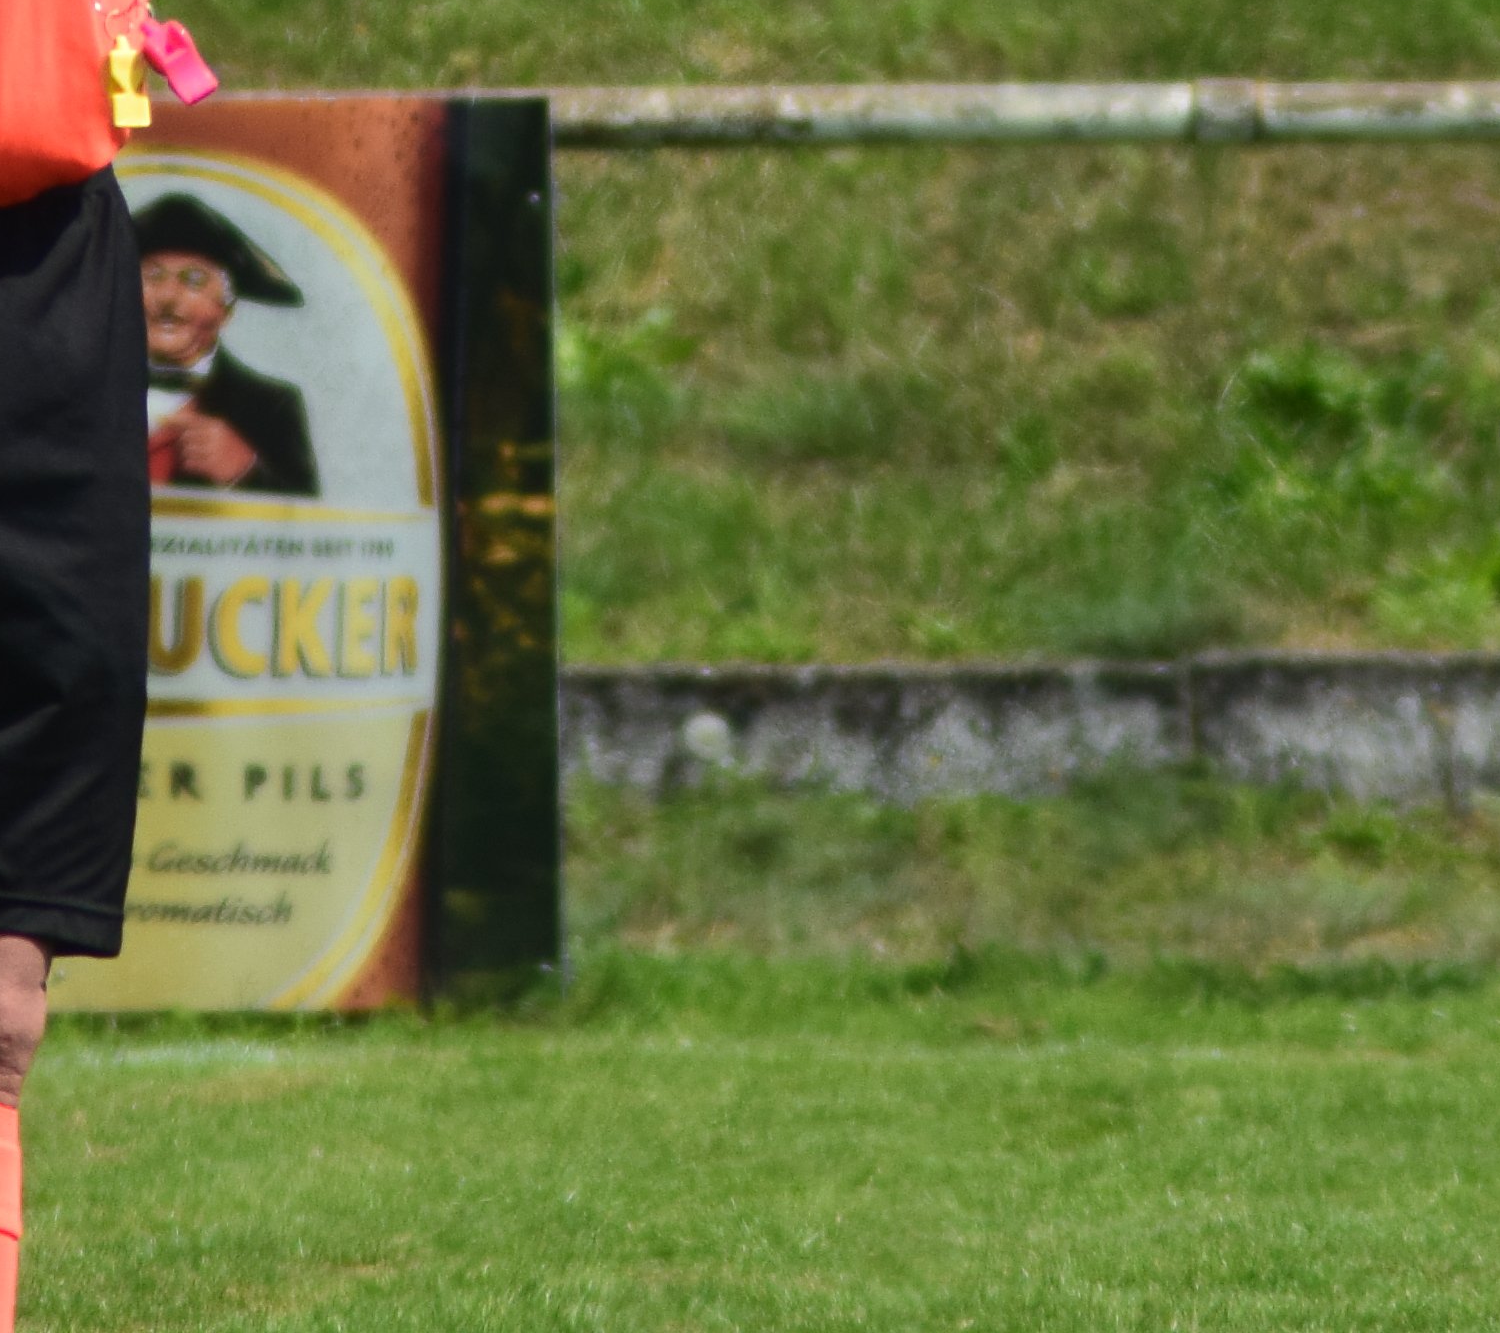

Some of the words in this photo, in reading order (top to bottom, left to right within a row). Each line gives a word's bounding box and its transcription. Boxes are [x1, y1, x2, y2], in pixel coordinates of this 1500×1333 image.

[149, 573, 419, 679] UCKER
[139, 759, 202, 802] ER
[243, 761, 366, 803] PILS
[149, 839, 331, 875] Geschmack
[125, 891, 293, 925] romatisch
